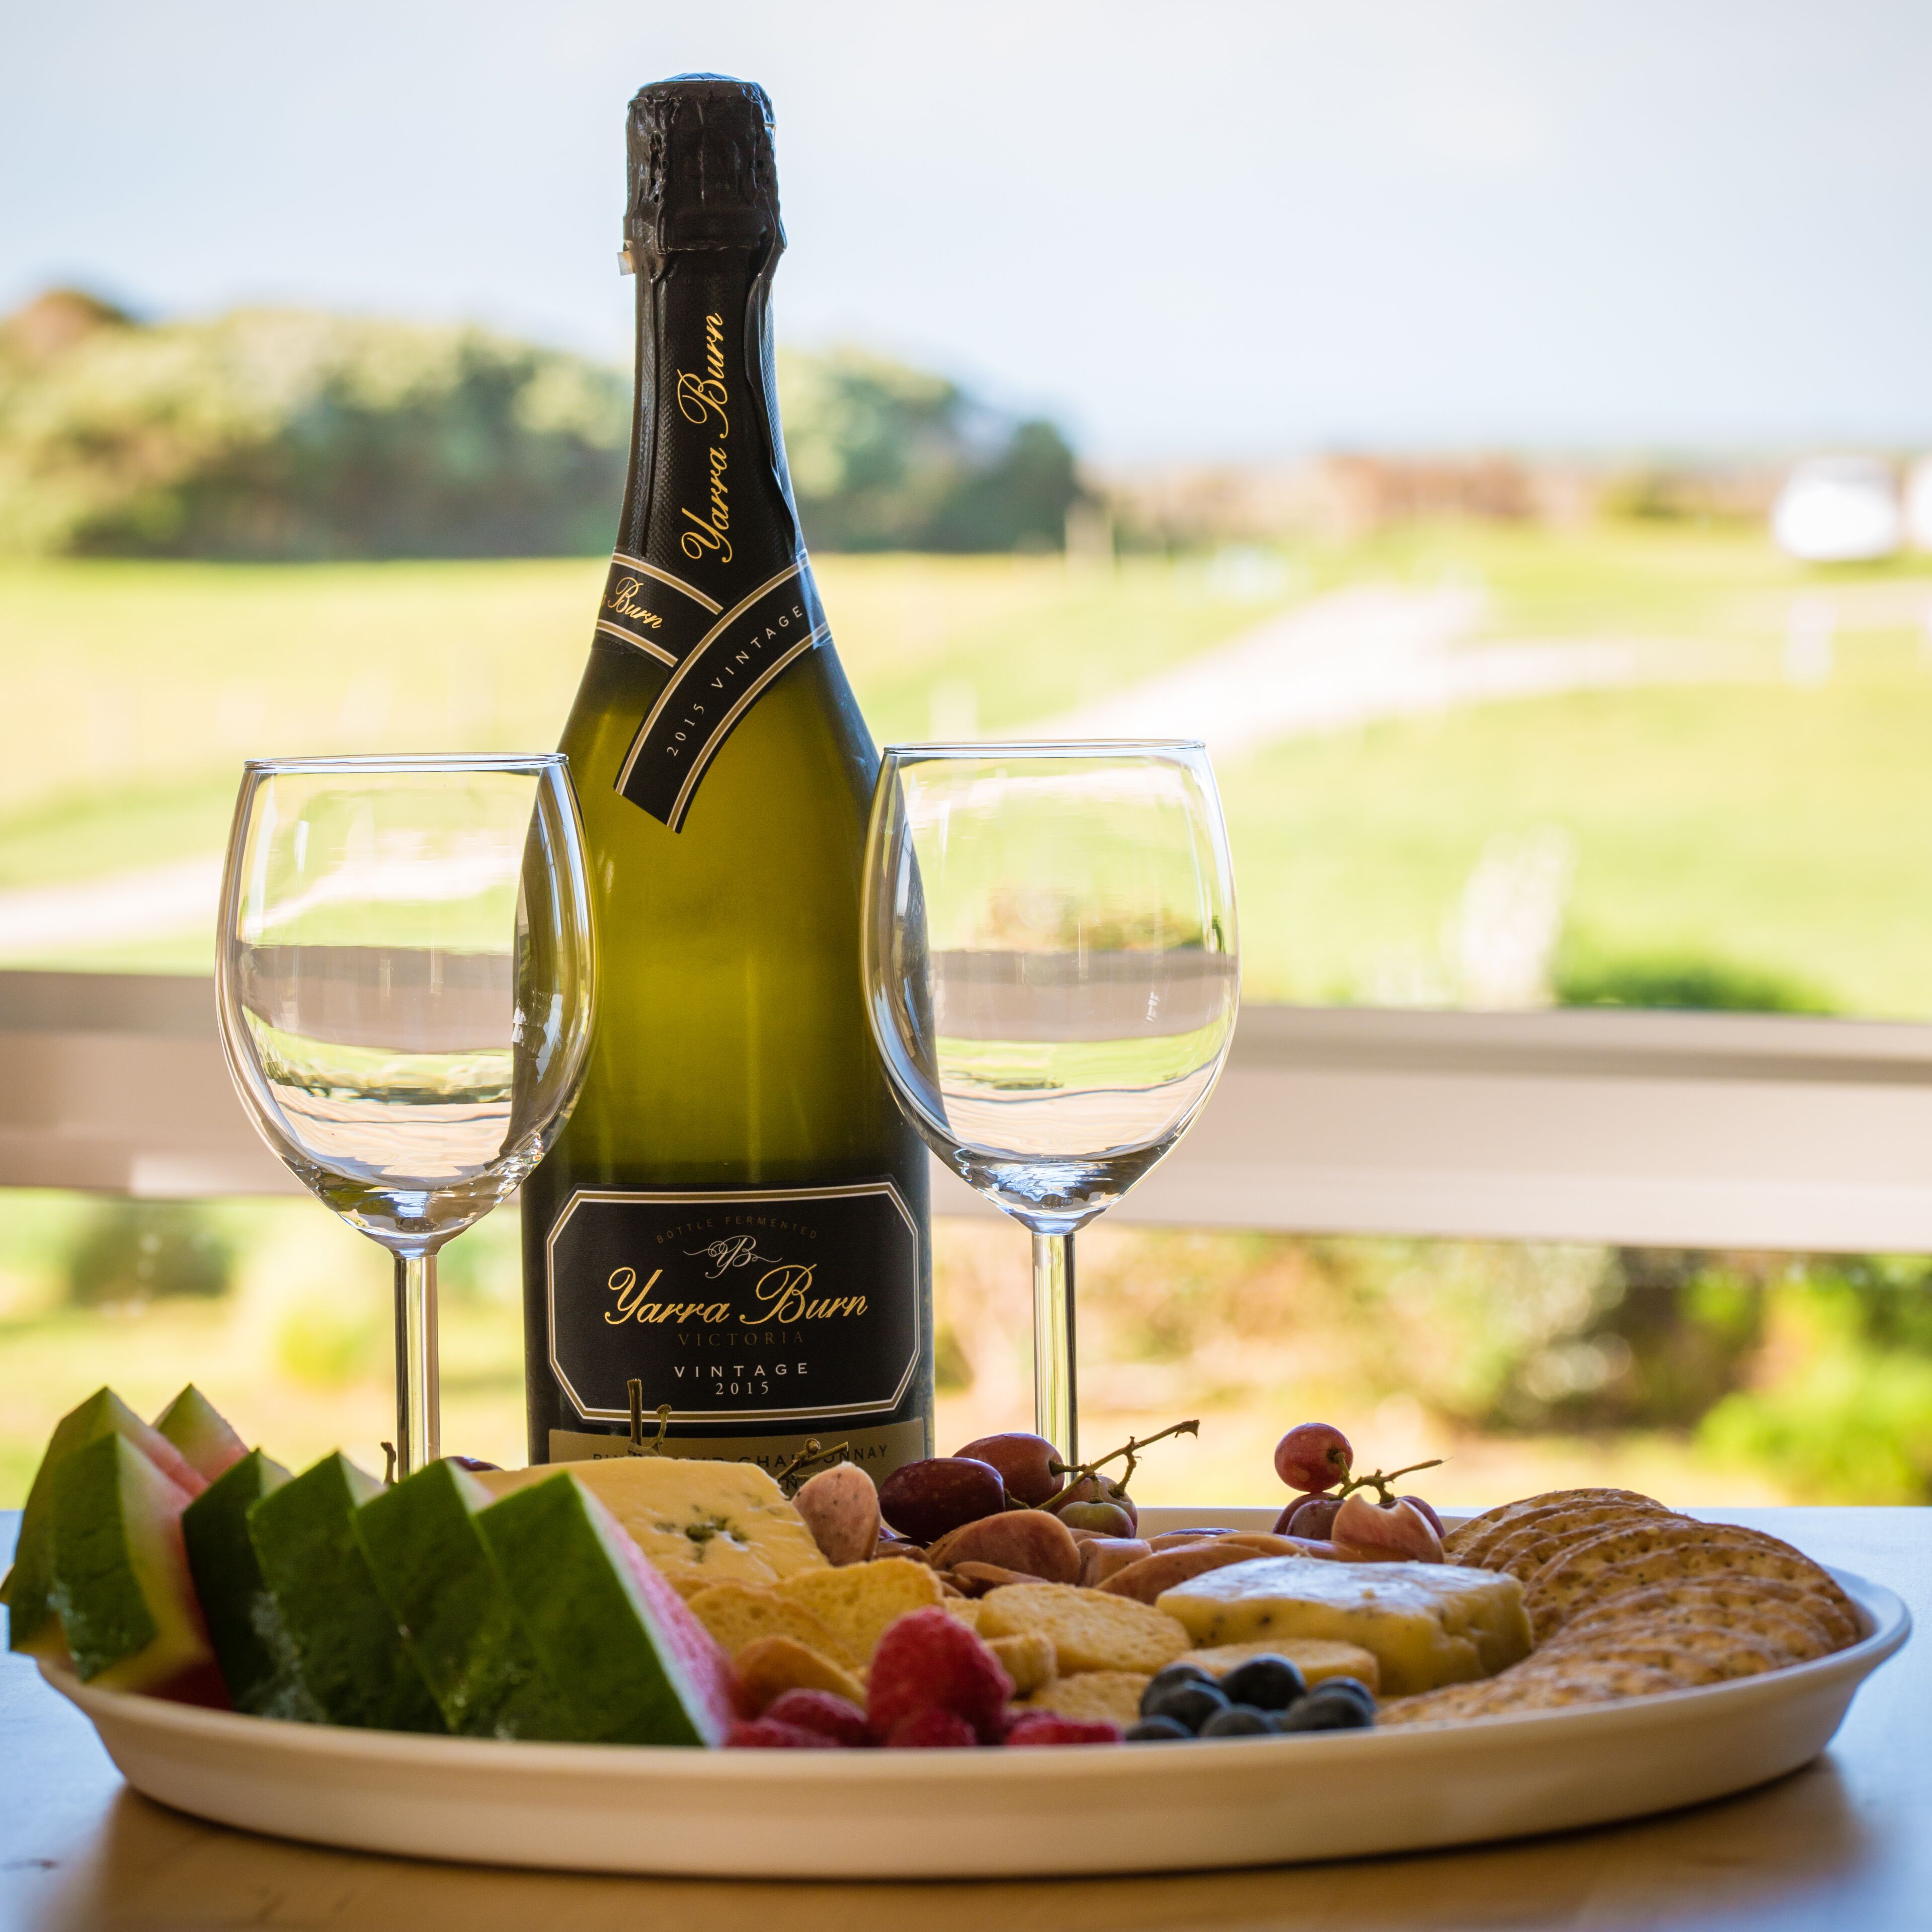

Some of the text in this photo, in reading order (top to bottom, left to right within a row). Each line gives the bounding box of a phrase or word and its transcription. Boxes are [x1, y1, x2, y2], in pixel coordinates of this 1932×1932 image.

[677, 312, 733, 564] Yarra Burn
[607, 577, 663, 628] Burn
[666, 606, 803, 757] 2015 VINTAGE
[656, 1216, 817, 1244] BOTTLE FERMENTED
[604, 1263, 868, 1325] Yarra Burn
[678, 1331, 803, 1346] VICTORIA
[674, 1362, 808, 1378] VINTAGE
[715, 1381, 769, 1395] 2015
